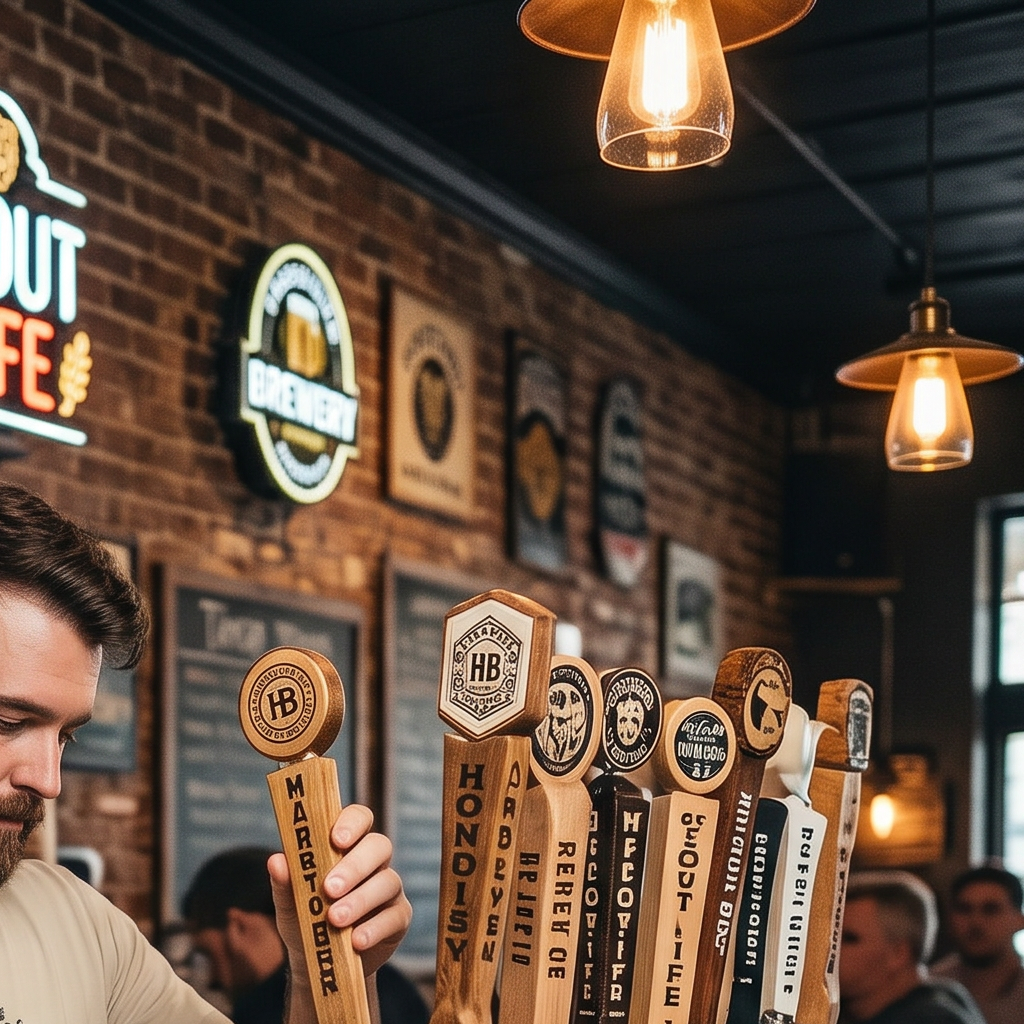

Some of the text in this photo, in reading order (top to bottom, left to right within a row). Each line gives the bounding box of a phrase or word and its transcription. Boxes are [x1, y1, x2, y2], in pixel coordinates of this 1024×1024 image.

[470, 652, 501, 682] HB
[266, 686, 299, 721] HB
[444, 763, 485, 962] HONDISY
